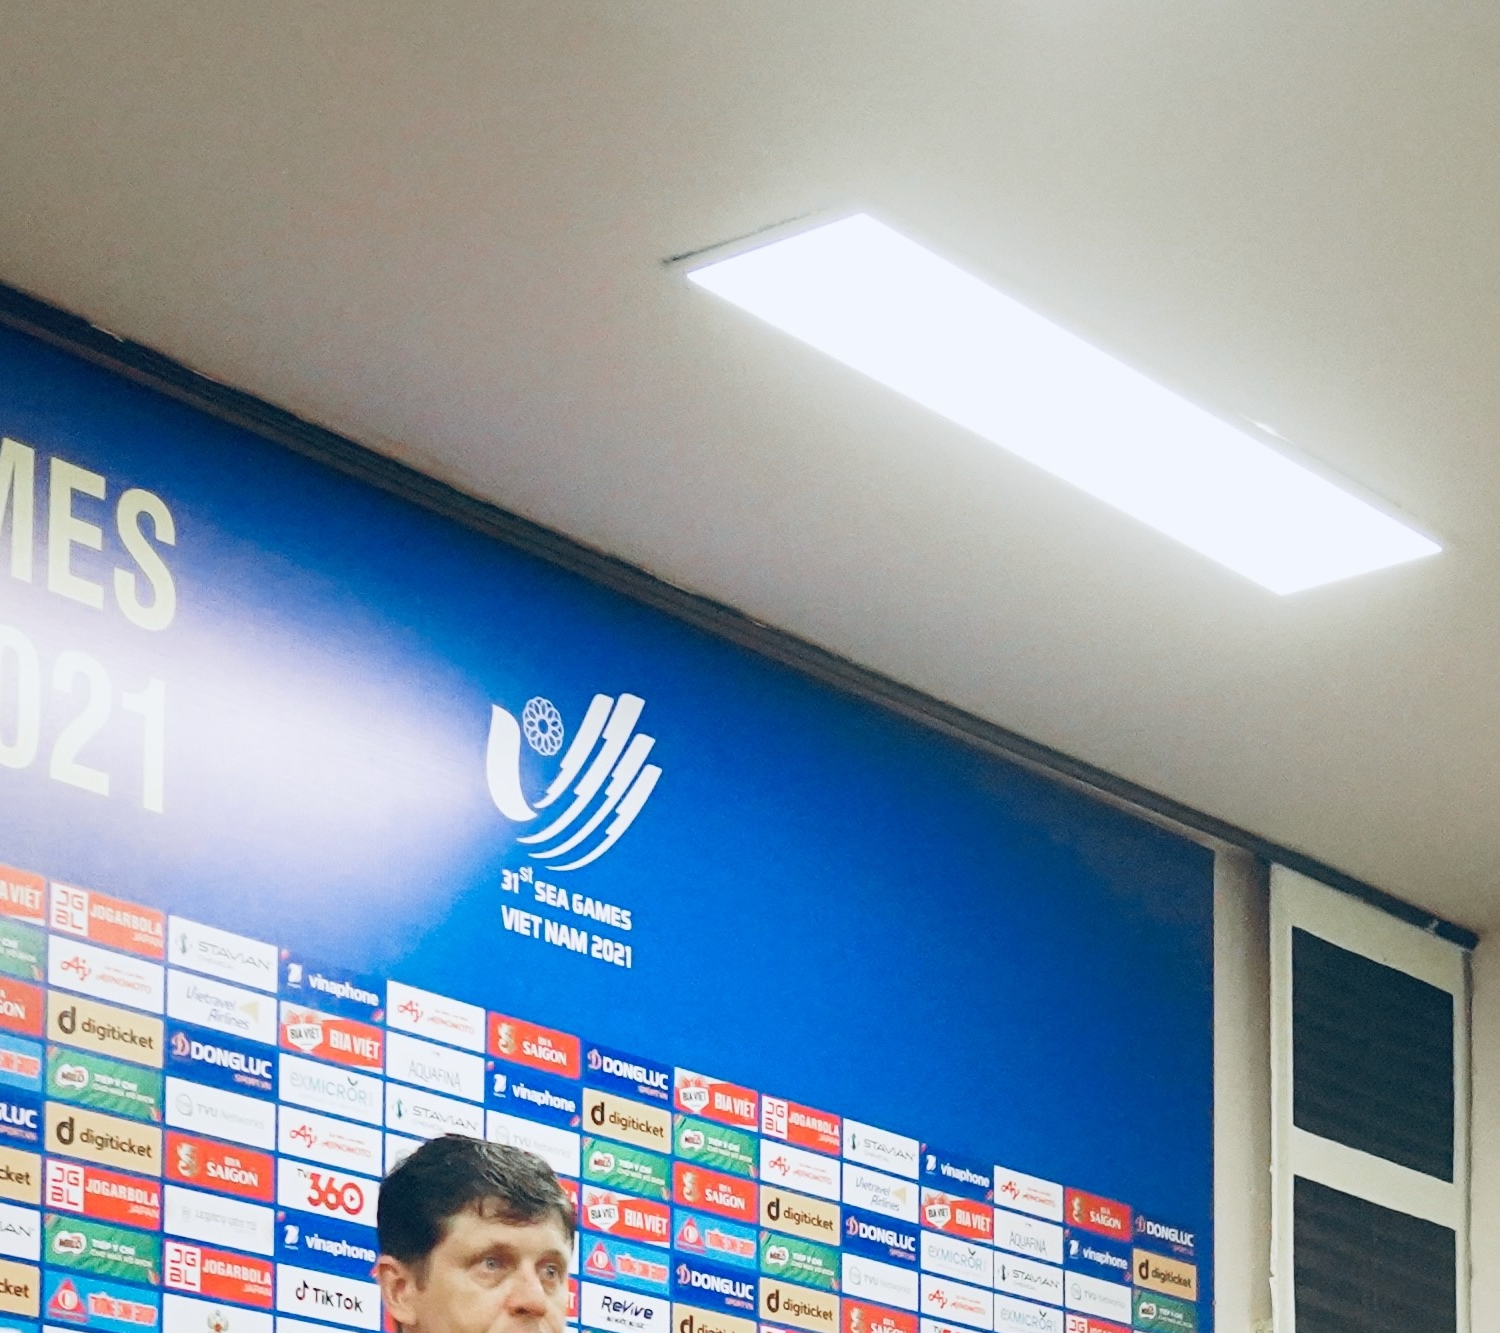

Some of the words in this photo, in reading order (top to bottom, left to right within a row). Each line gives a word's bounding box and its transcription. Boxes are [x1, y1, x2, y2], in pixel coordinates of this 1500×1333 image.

[501, 866, 533, 894] 31st
[534, 880, 569, 911] SEA
[572, 893, 632, 931] GAMES
[501, 905, 542, 939] VIET
[544, 919, 587, 954] NAM
[591, 935, 632, 968] 2021
[308, 973, 377, 1006] vinaphone
[81, 1017, 153, 1049] digiticket
[329, 1029, 351, 1053] BIA
[512, 1082, 574, 1112] vinaphone
[713, 1092, 731, 1113] BIA
[607, 1111, 663, 1138] digiticket
[939, 1161, 987, 1187] vinaphone
[85, 1176, 158, 1208] JOGARBOLA
[782, 1207, 832, 1231] digiticket
[201, 1257, 271, 1287] JOGARBOLA
[312, 1287, 362, 1314] TikTok
